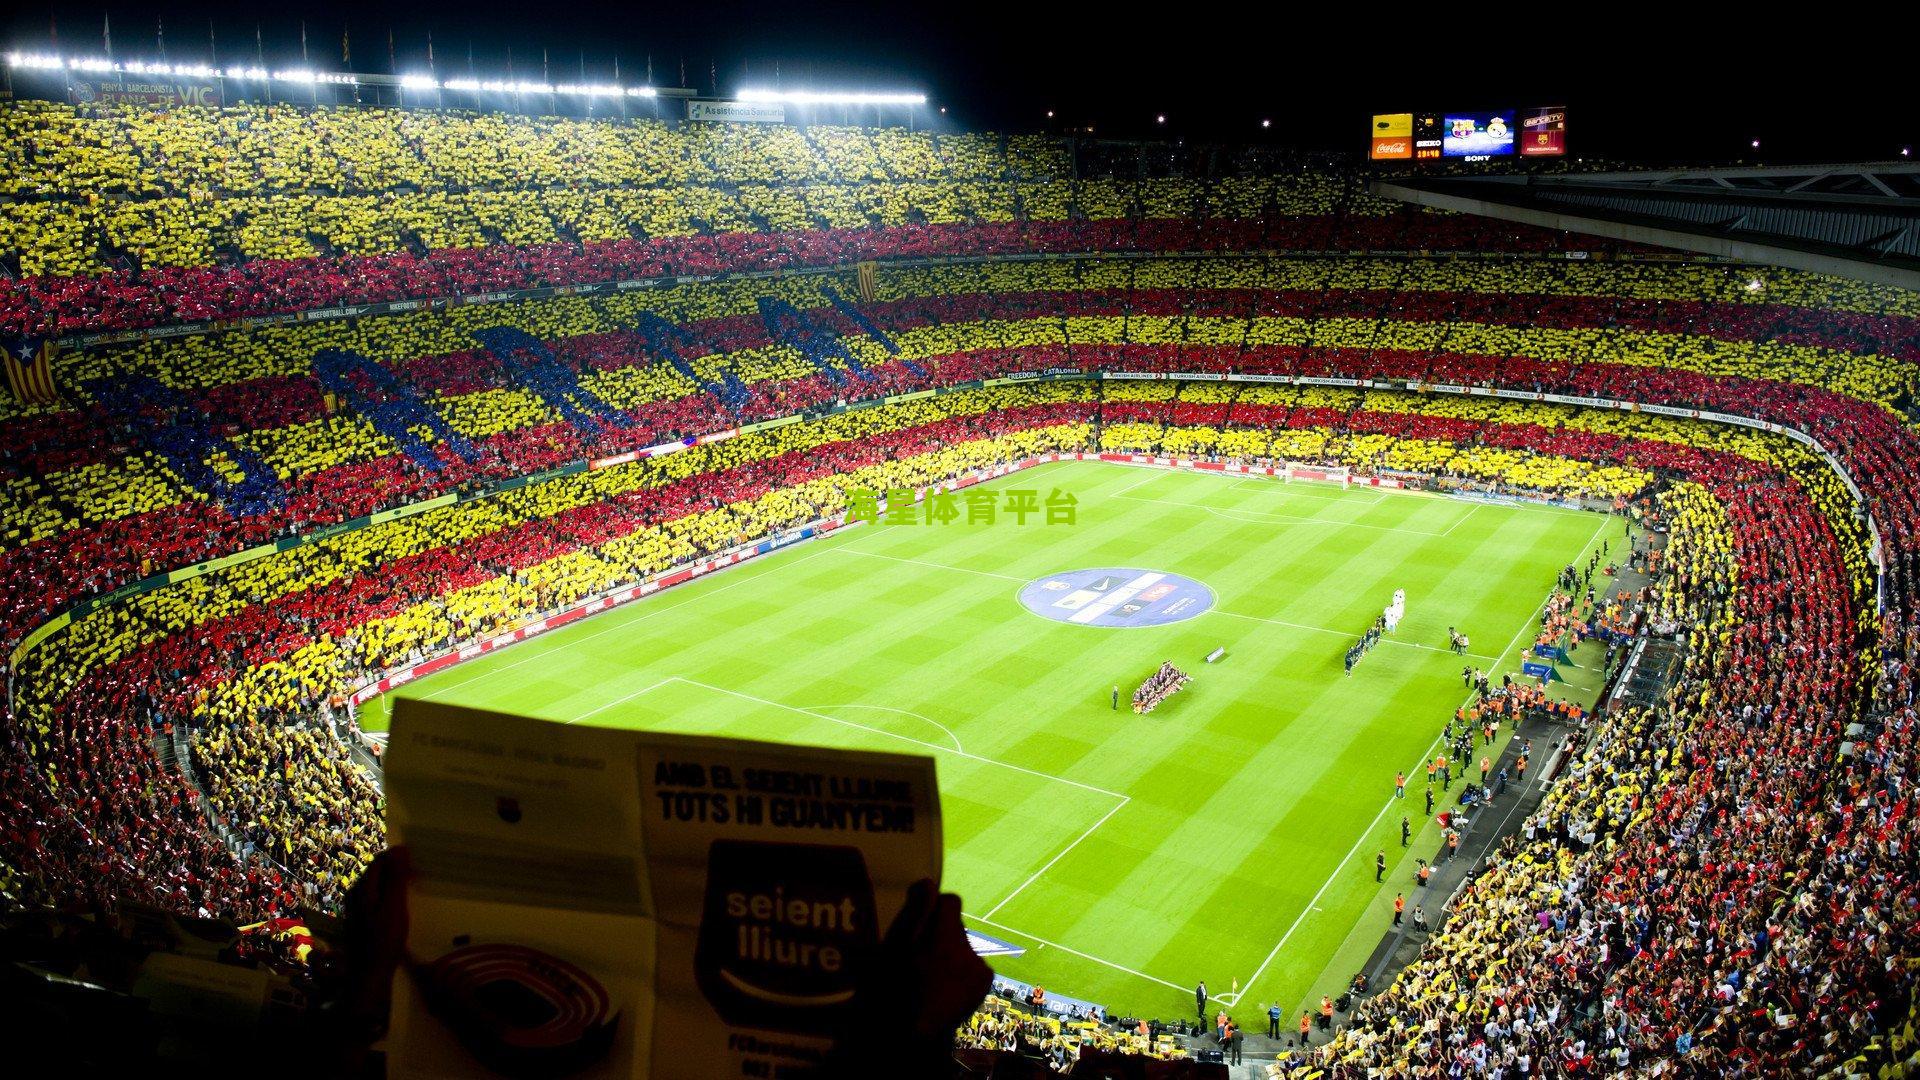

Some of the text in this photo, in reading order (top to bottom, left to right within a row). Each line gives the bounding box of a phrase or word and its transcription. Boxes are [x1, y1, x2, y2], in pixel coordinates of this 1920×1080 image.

[102, 84, 123, 92] PENYA
[158, 96, 175, 105] DE
[178, 86, 213, 106] VIC
[308, 308, 357, 320] NIKEFOOTBALL.COM
[1044, 368, 1080, 376] CATALONIA
[1715, 414, 1762, 427] TURKISH AIRLINES
[656, 762, 912, 800] AMB EL SEIENT LLIURE
[658, 792, 730, 822] TOTS
[736, 795, 762, 824] HI
[726, 884, 856, 935] seient
[738, 922, 844, 974] lliure
